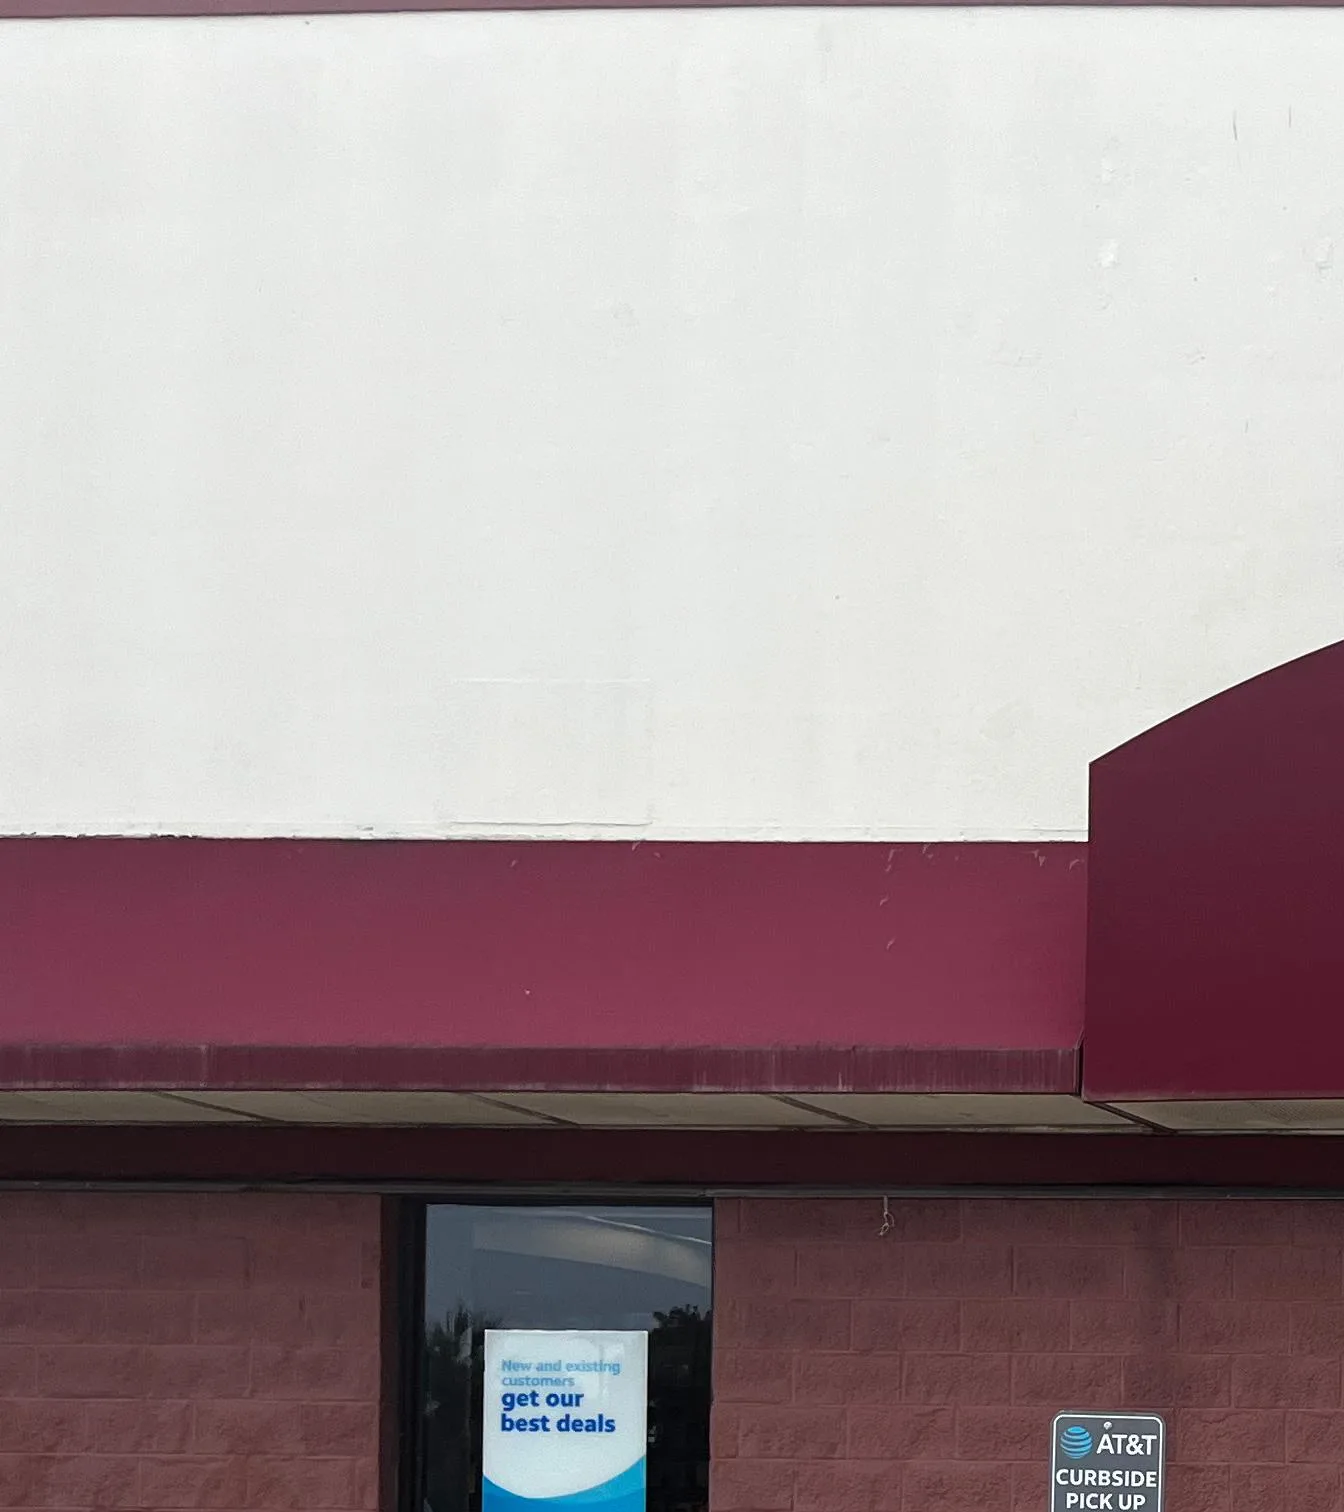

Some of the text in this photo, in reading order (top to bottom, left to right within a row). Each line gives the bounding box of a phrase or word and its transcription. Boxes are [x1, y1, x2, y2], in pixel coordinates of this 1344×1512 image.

[502, 1360, 620, 1375] New and existing
[502, 1377, 575, 1386] customers
[501, 1390, 584, 1411] get our
[501, 1413, 616, 1433] best deals
[1096, 1434, 1157, 1455] AT&T
[1056, 1469, 1157, 1488] CURBSIDE
[1066, 1493, 1146, 1510] PICK UP
